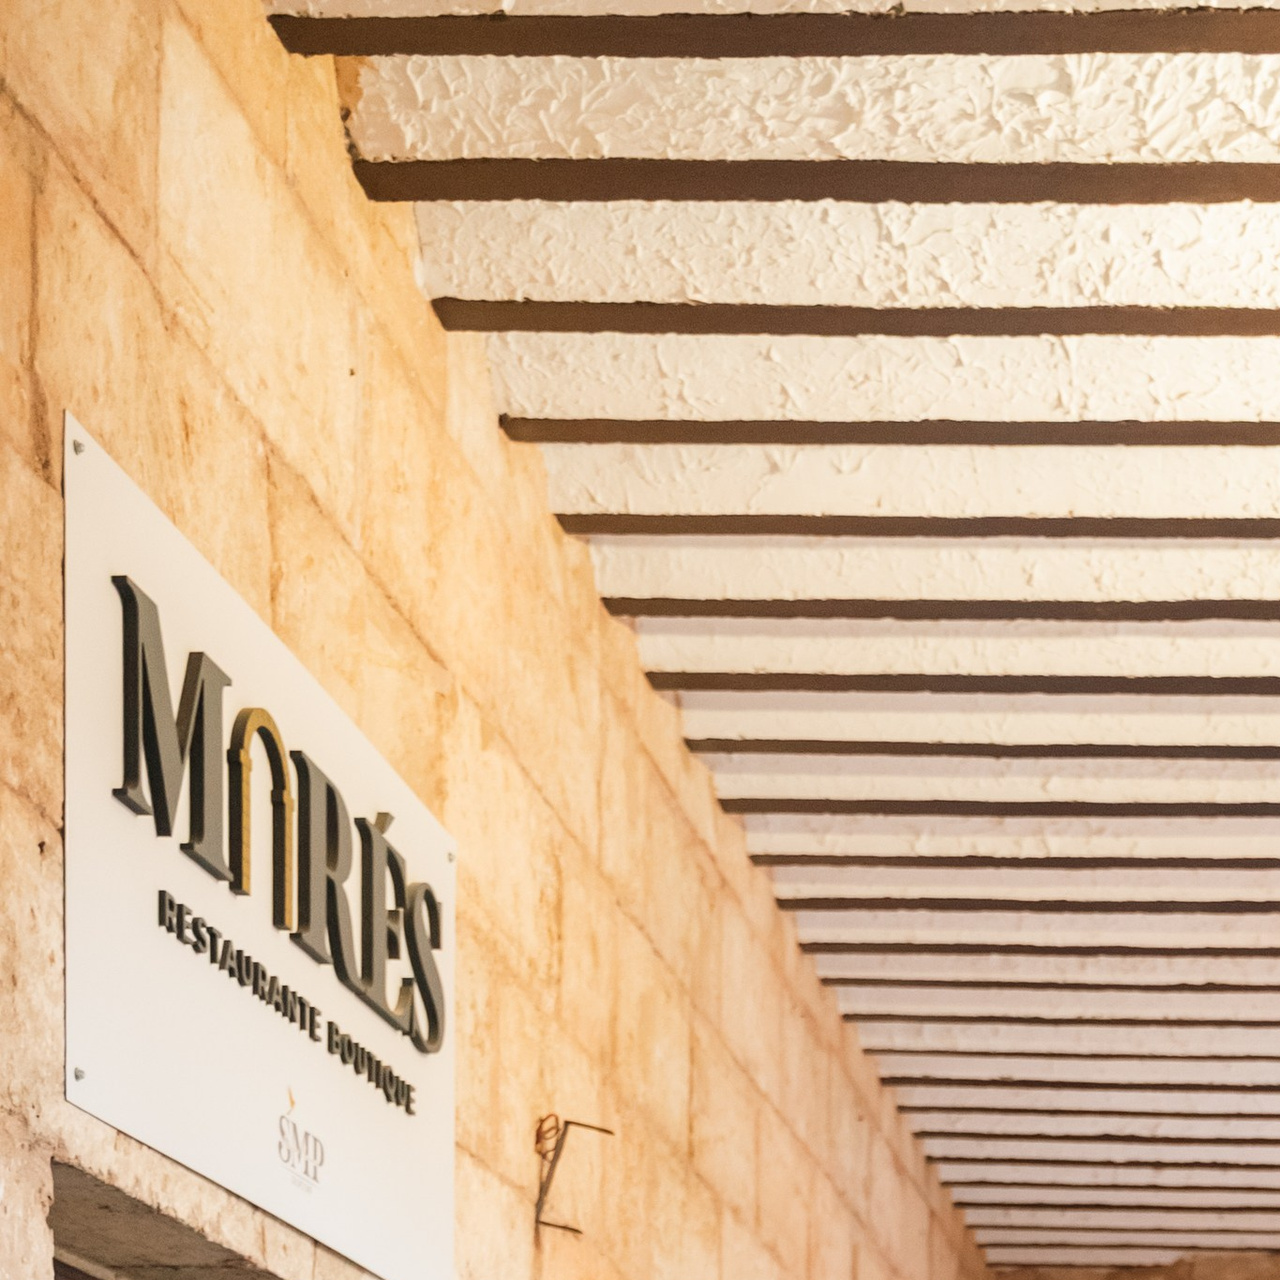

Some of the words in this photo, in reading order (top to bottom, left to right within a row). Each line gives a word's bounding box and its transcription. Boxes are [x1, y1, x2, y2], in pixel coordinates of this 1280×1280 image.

[157, 889, 322, 1042] RESTAURANTE
[326, 1020, 416, 1116] BOUTIQUE
[278, 1114, 325, 1184] SMP
